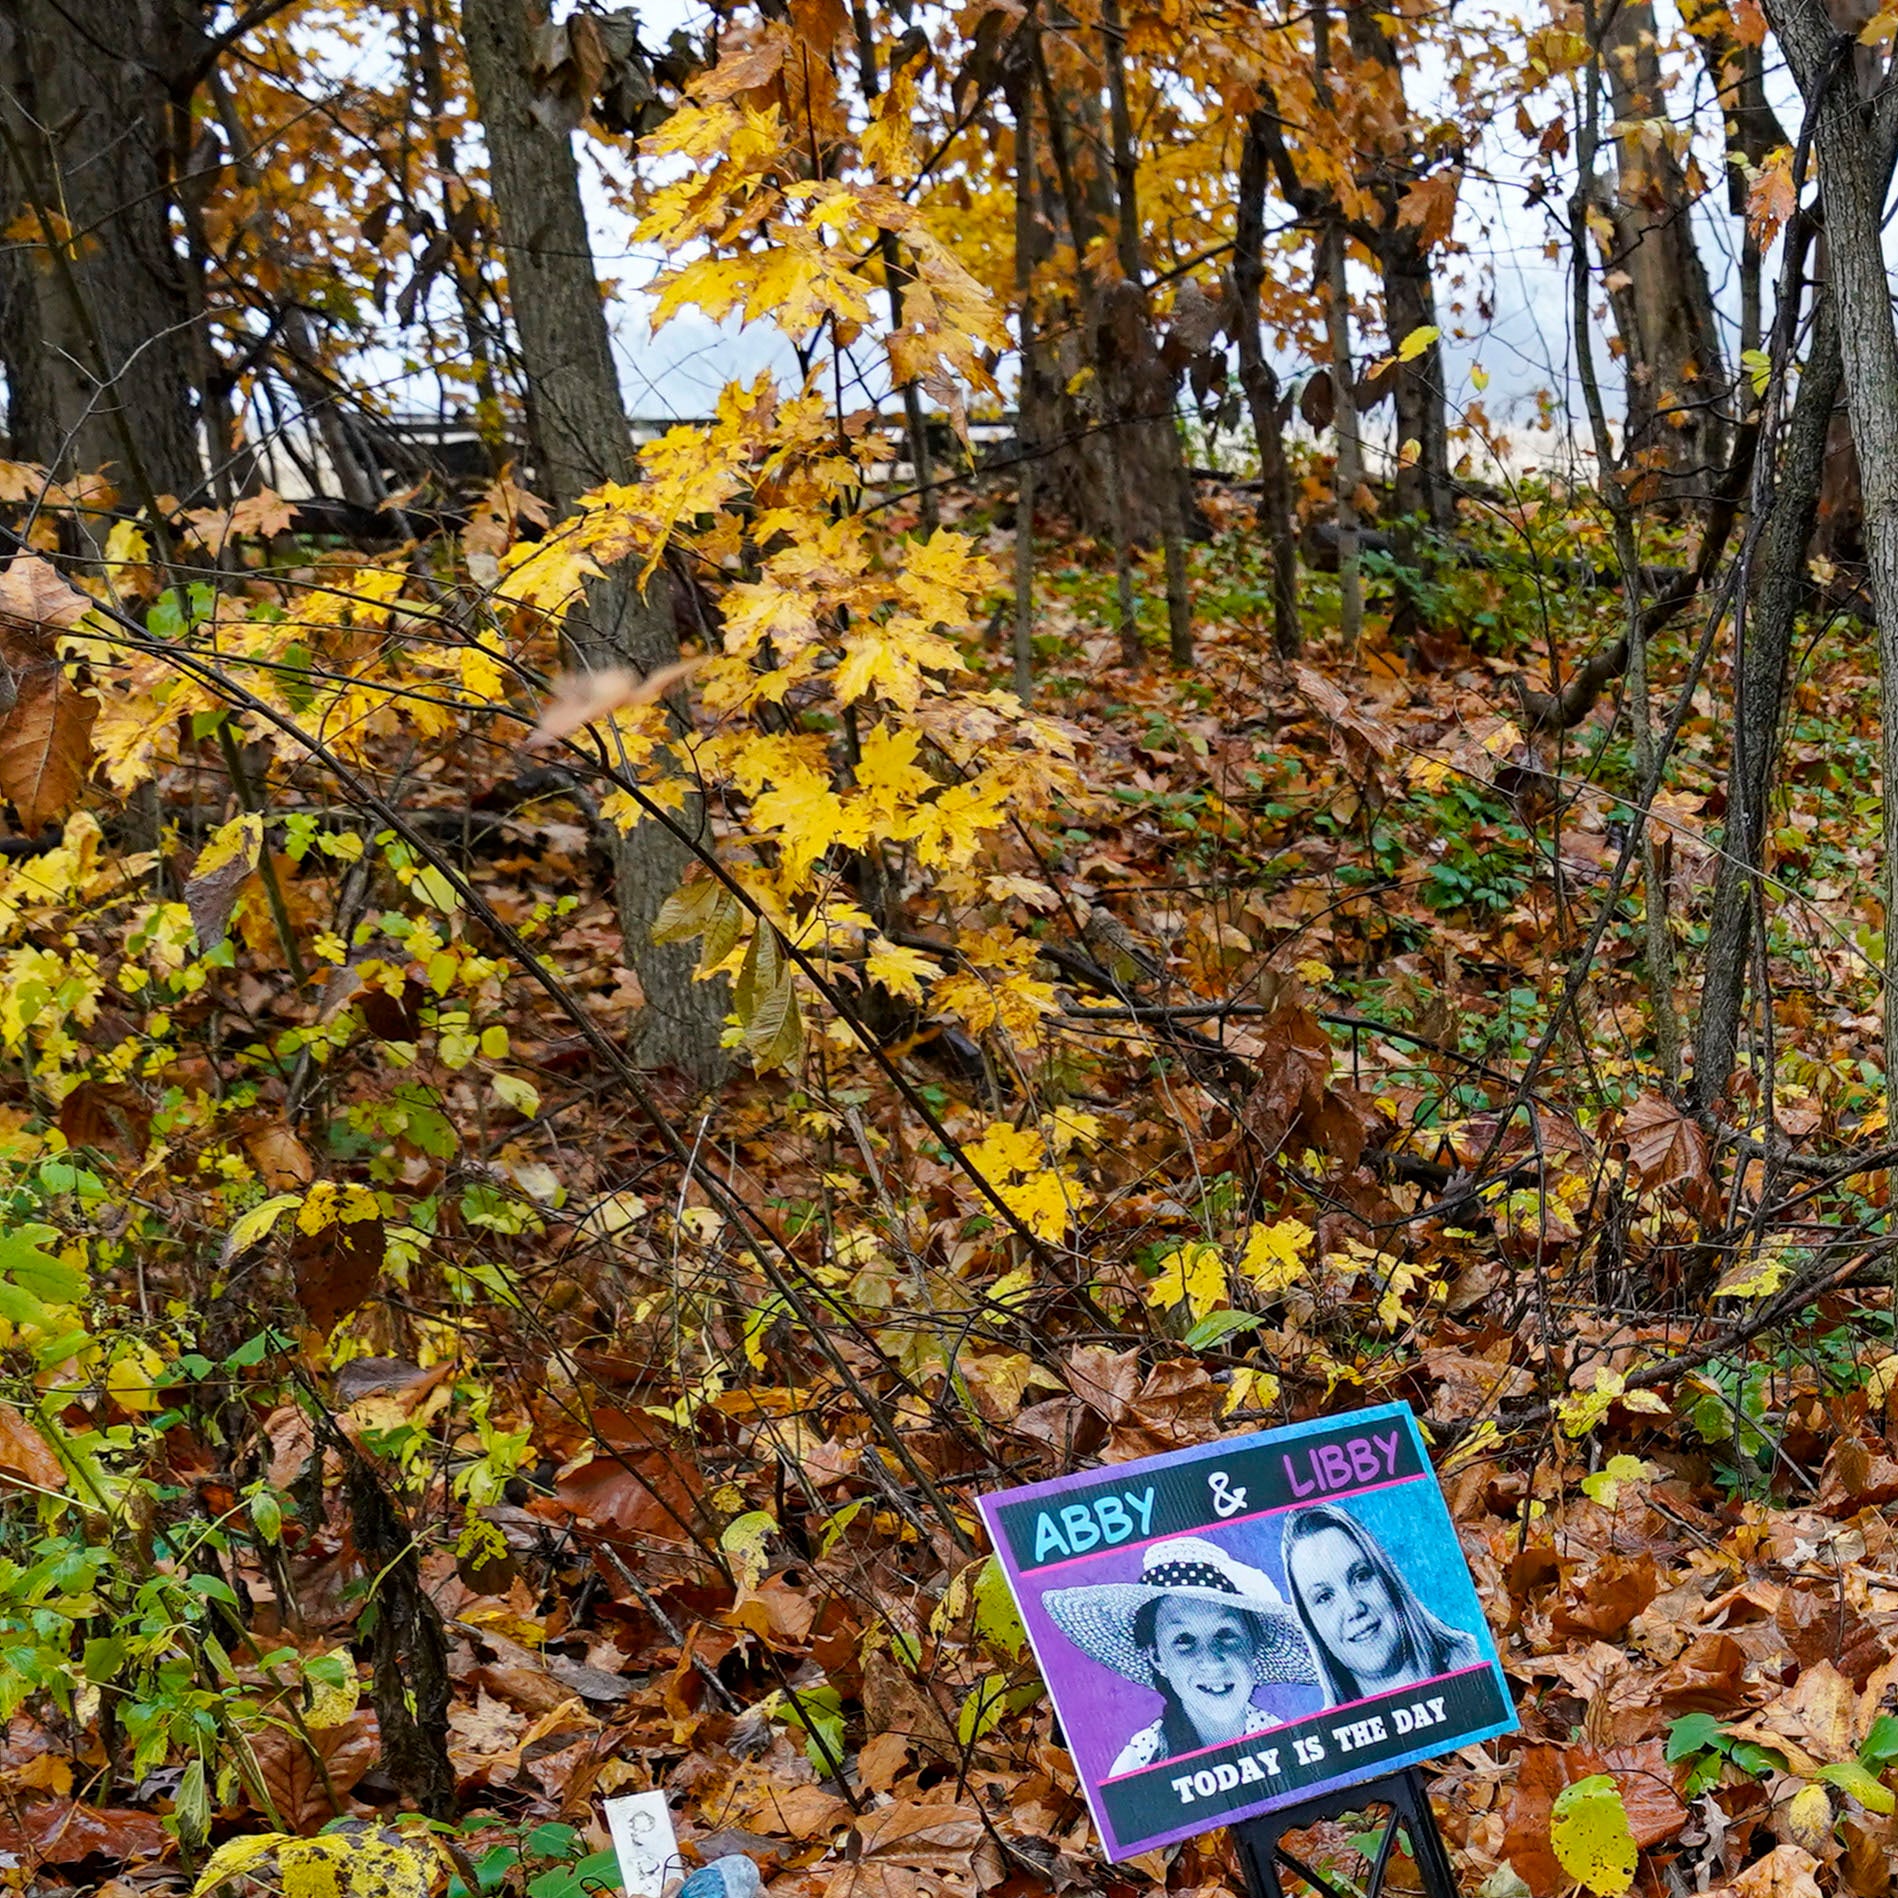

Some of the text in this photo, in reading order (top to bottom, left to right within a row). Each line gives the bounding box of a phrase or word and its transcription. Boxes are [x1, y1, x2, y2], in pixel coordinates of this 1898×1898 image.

[1033, 1430, 1400, 1562] ABBY & LIBBY
[1171, 1697, 1447, 1804] TODAY IS THE DAY
